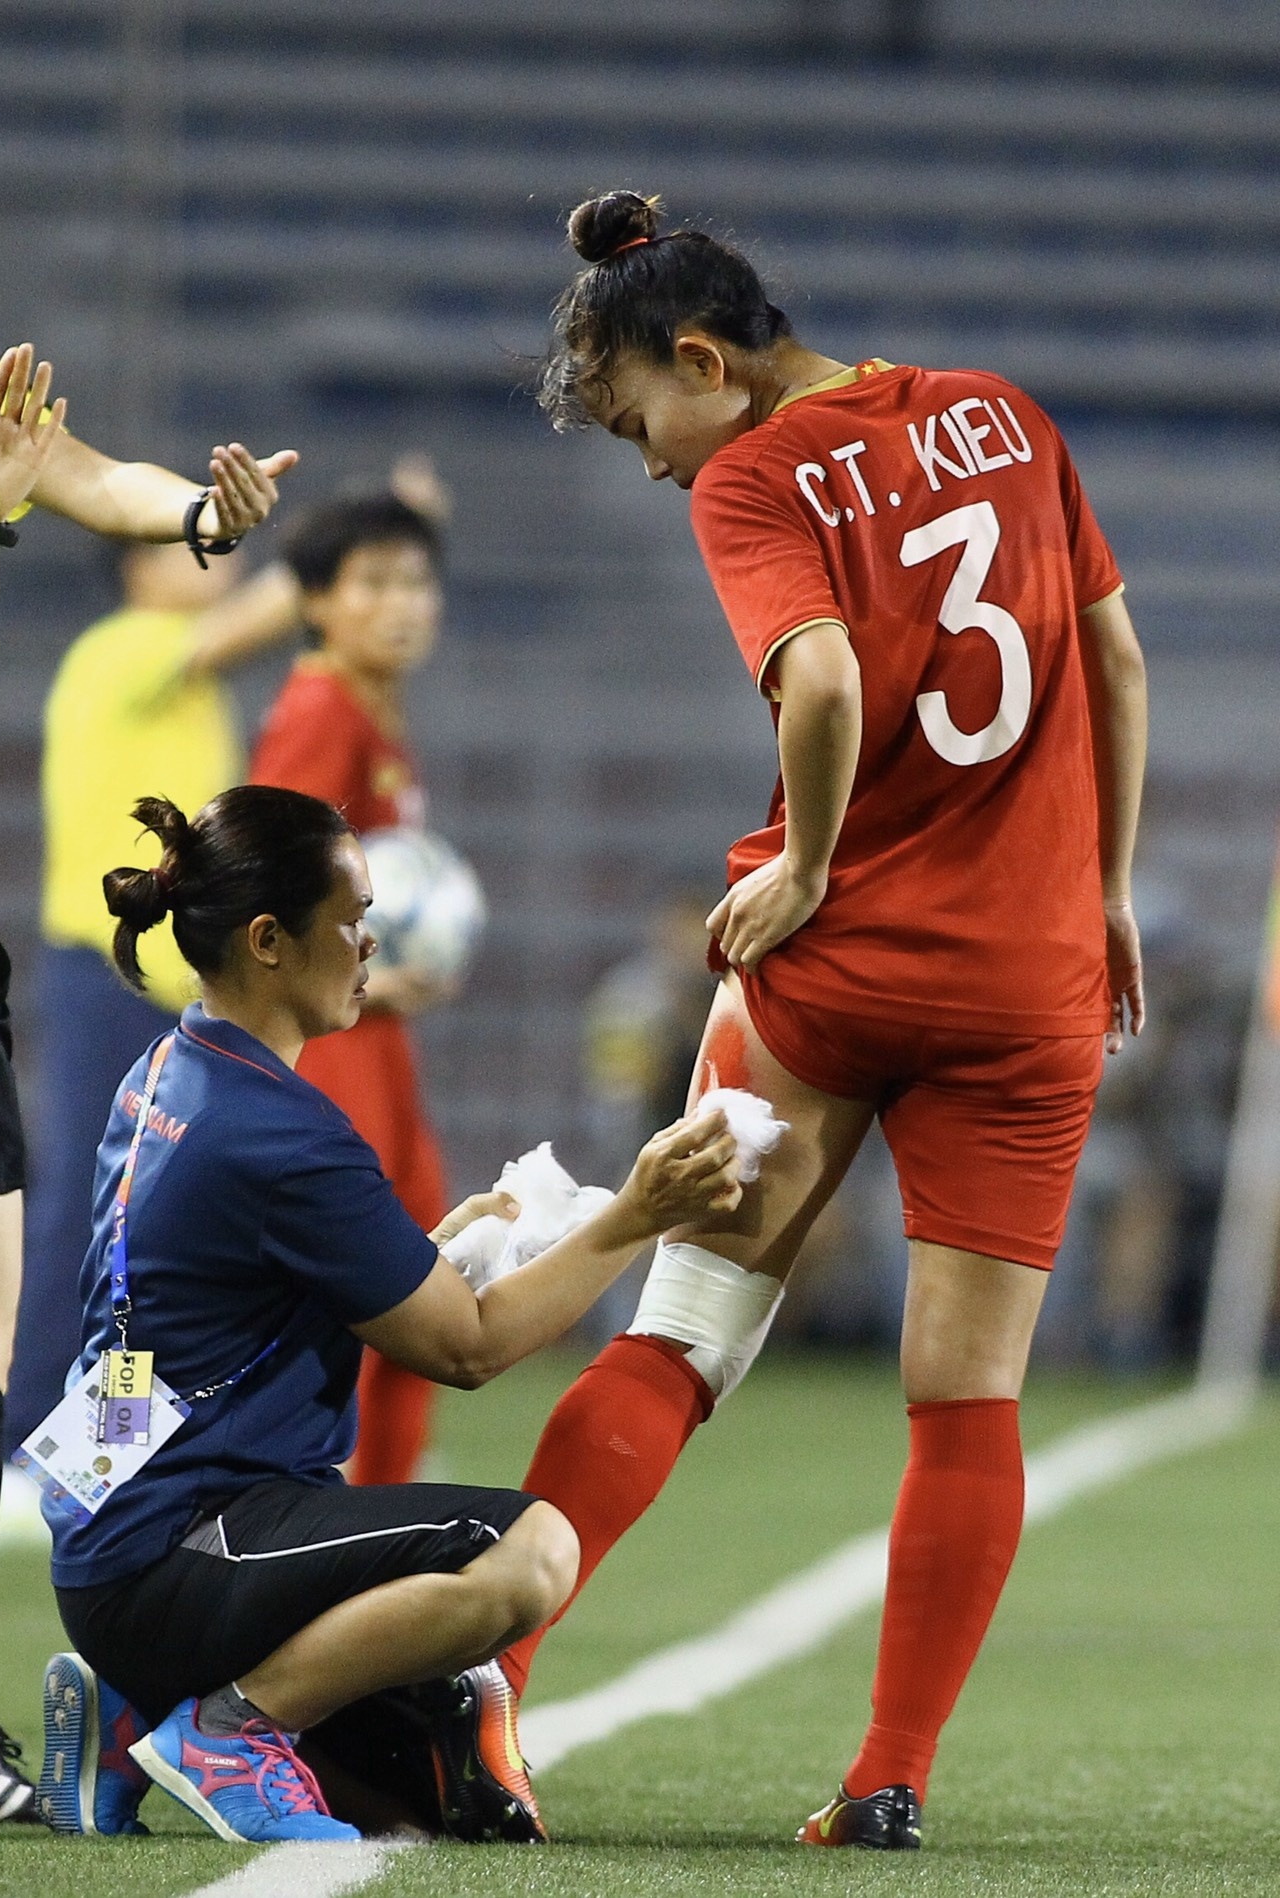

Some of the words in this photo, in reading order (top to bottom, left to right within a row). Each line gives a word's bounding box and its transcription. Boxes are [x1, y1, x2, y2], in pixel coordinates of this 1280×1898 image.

[795, 439, 902, 528] C.T.
[906, 396, 1033, 493] KIEU
[898, 499, 1033, 767] 3
[119, 1356, 135, 1394] FOP
[115, 1407, 132, 1436] OA
